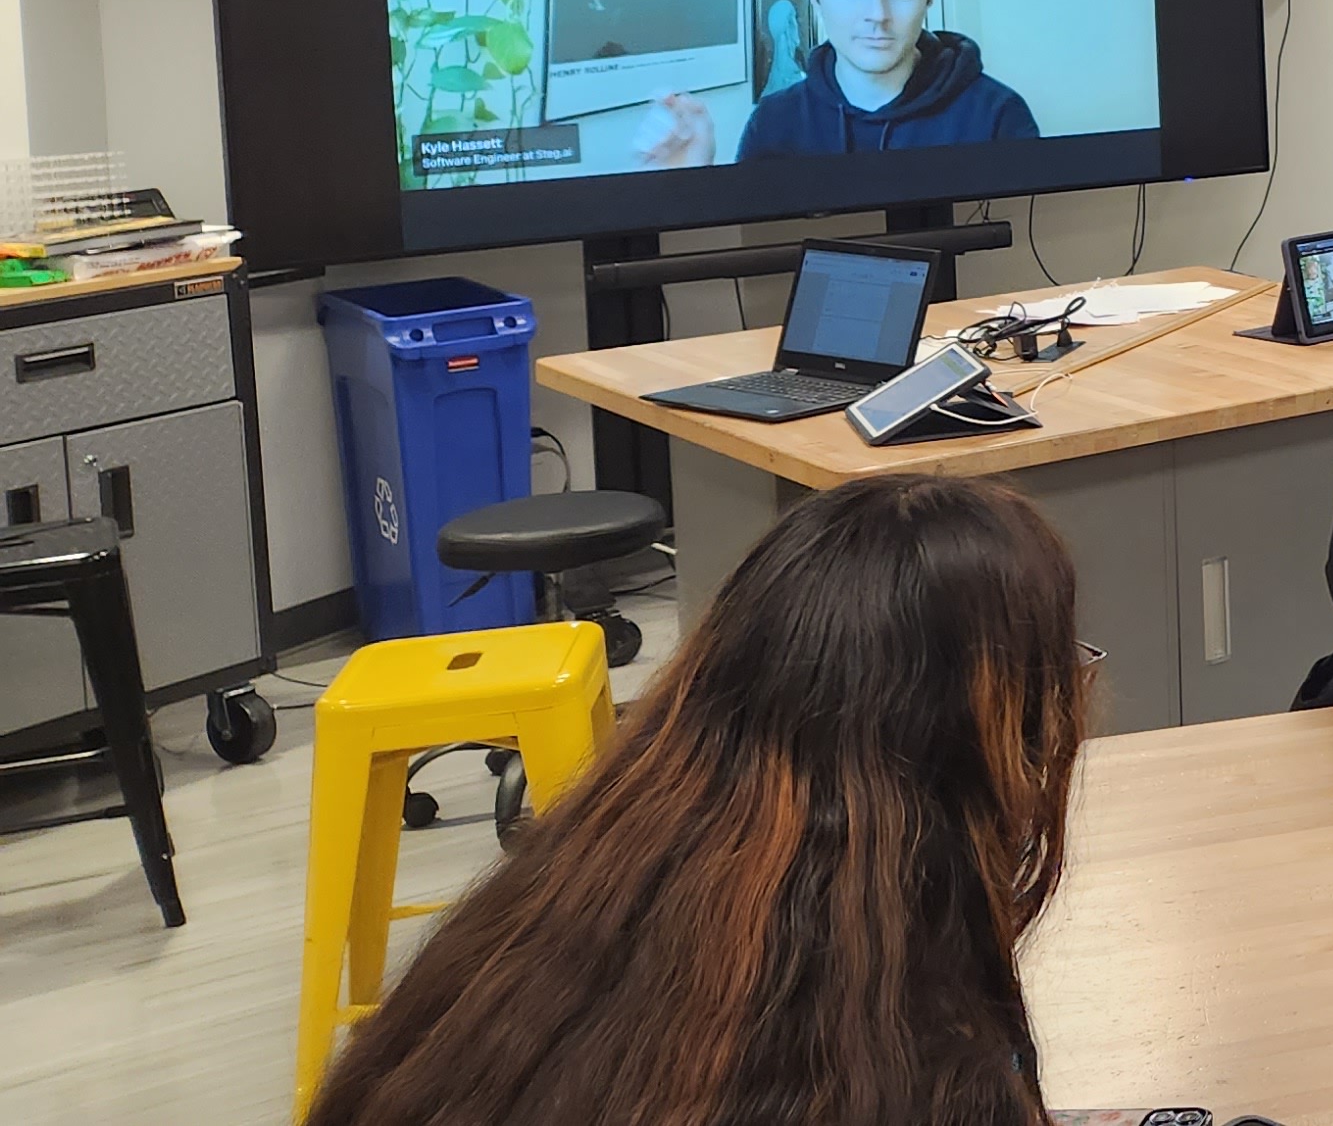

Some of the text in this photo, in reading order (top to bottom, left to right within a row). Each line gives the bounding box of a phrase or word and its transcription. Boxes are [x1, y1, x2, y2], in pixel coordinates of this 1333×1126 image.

[421, 137, 503, 155] Kyle Hassett
[422, 156, 472, 169] Software
[473, 152, 521, 166] Engineer
[523, 151, 534, 161] at
